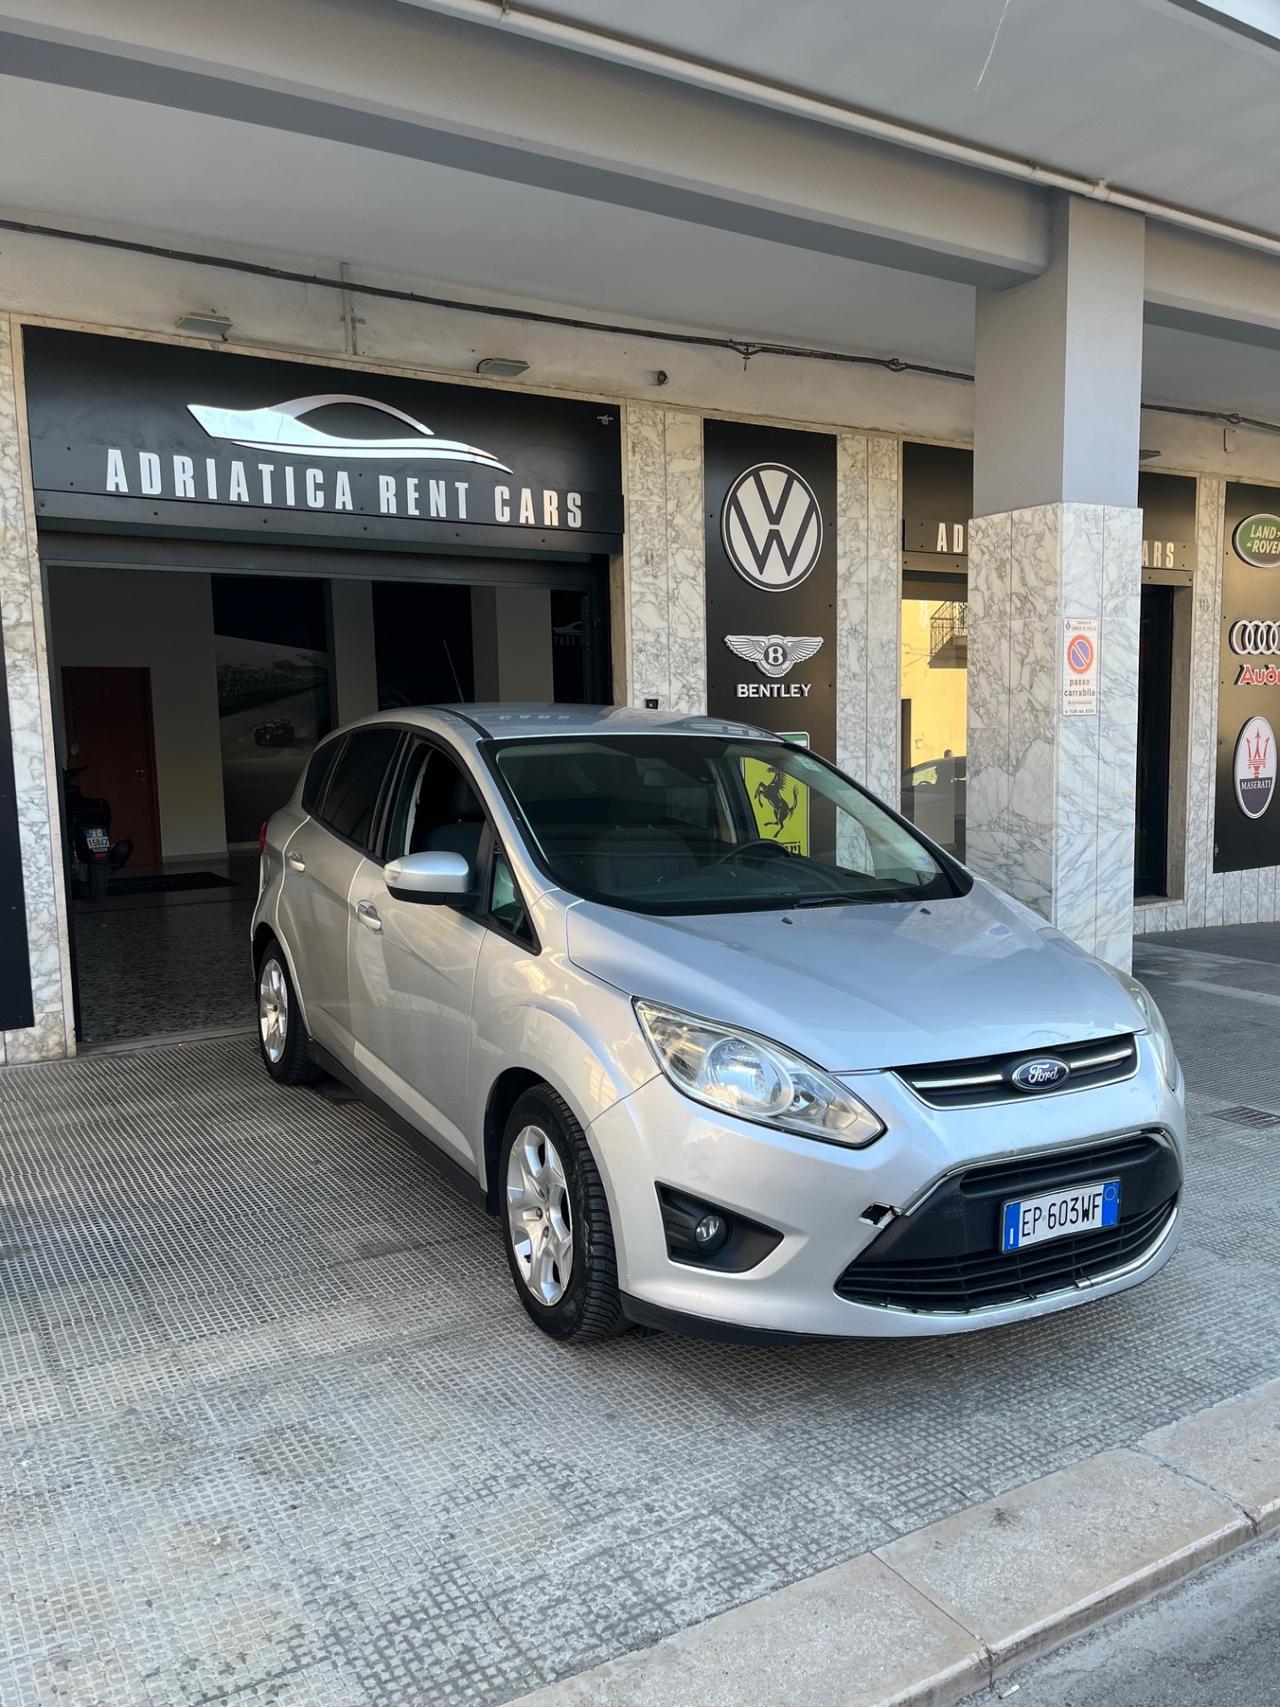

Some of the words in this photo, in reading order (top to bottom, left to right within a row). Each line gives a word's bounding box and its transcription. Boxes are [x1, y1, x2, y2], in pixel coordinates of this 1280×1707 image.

[106, 448, 354, 511] ADRIATICA
[378, 474, 469, 520] RENT
[494, 485, 583, 529] CARS
[1250, 525, 1277, 539] LAND
[936, 522, 964, 553] AD
[1143, 541, 1175, 568] ARS
[737, 683, 812, 698] BENTLEY
[1069, 679, 1090, 688] passo
[1063, 688, 1096, 697] carrabile
[1241, 780, 1271, 790] MASERATI
[1028, 1063, 1059, 1084] Ford
[1022, 1206, 1043, 1238] EP
[1047, 1193, 1103, 1231] 603WF
